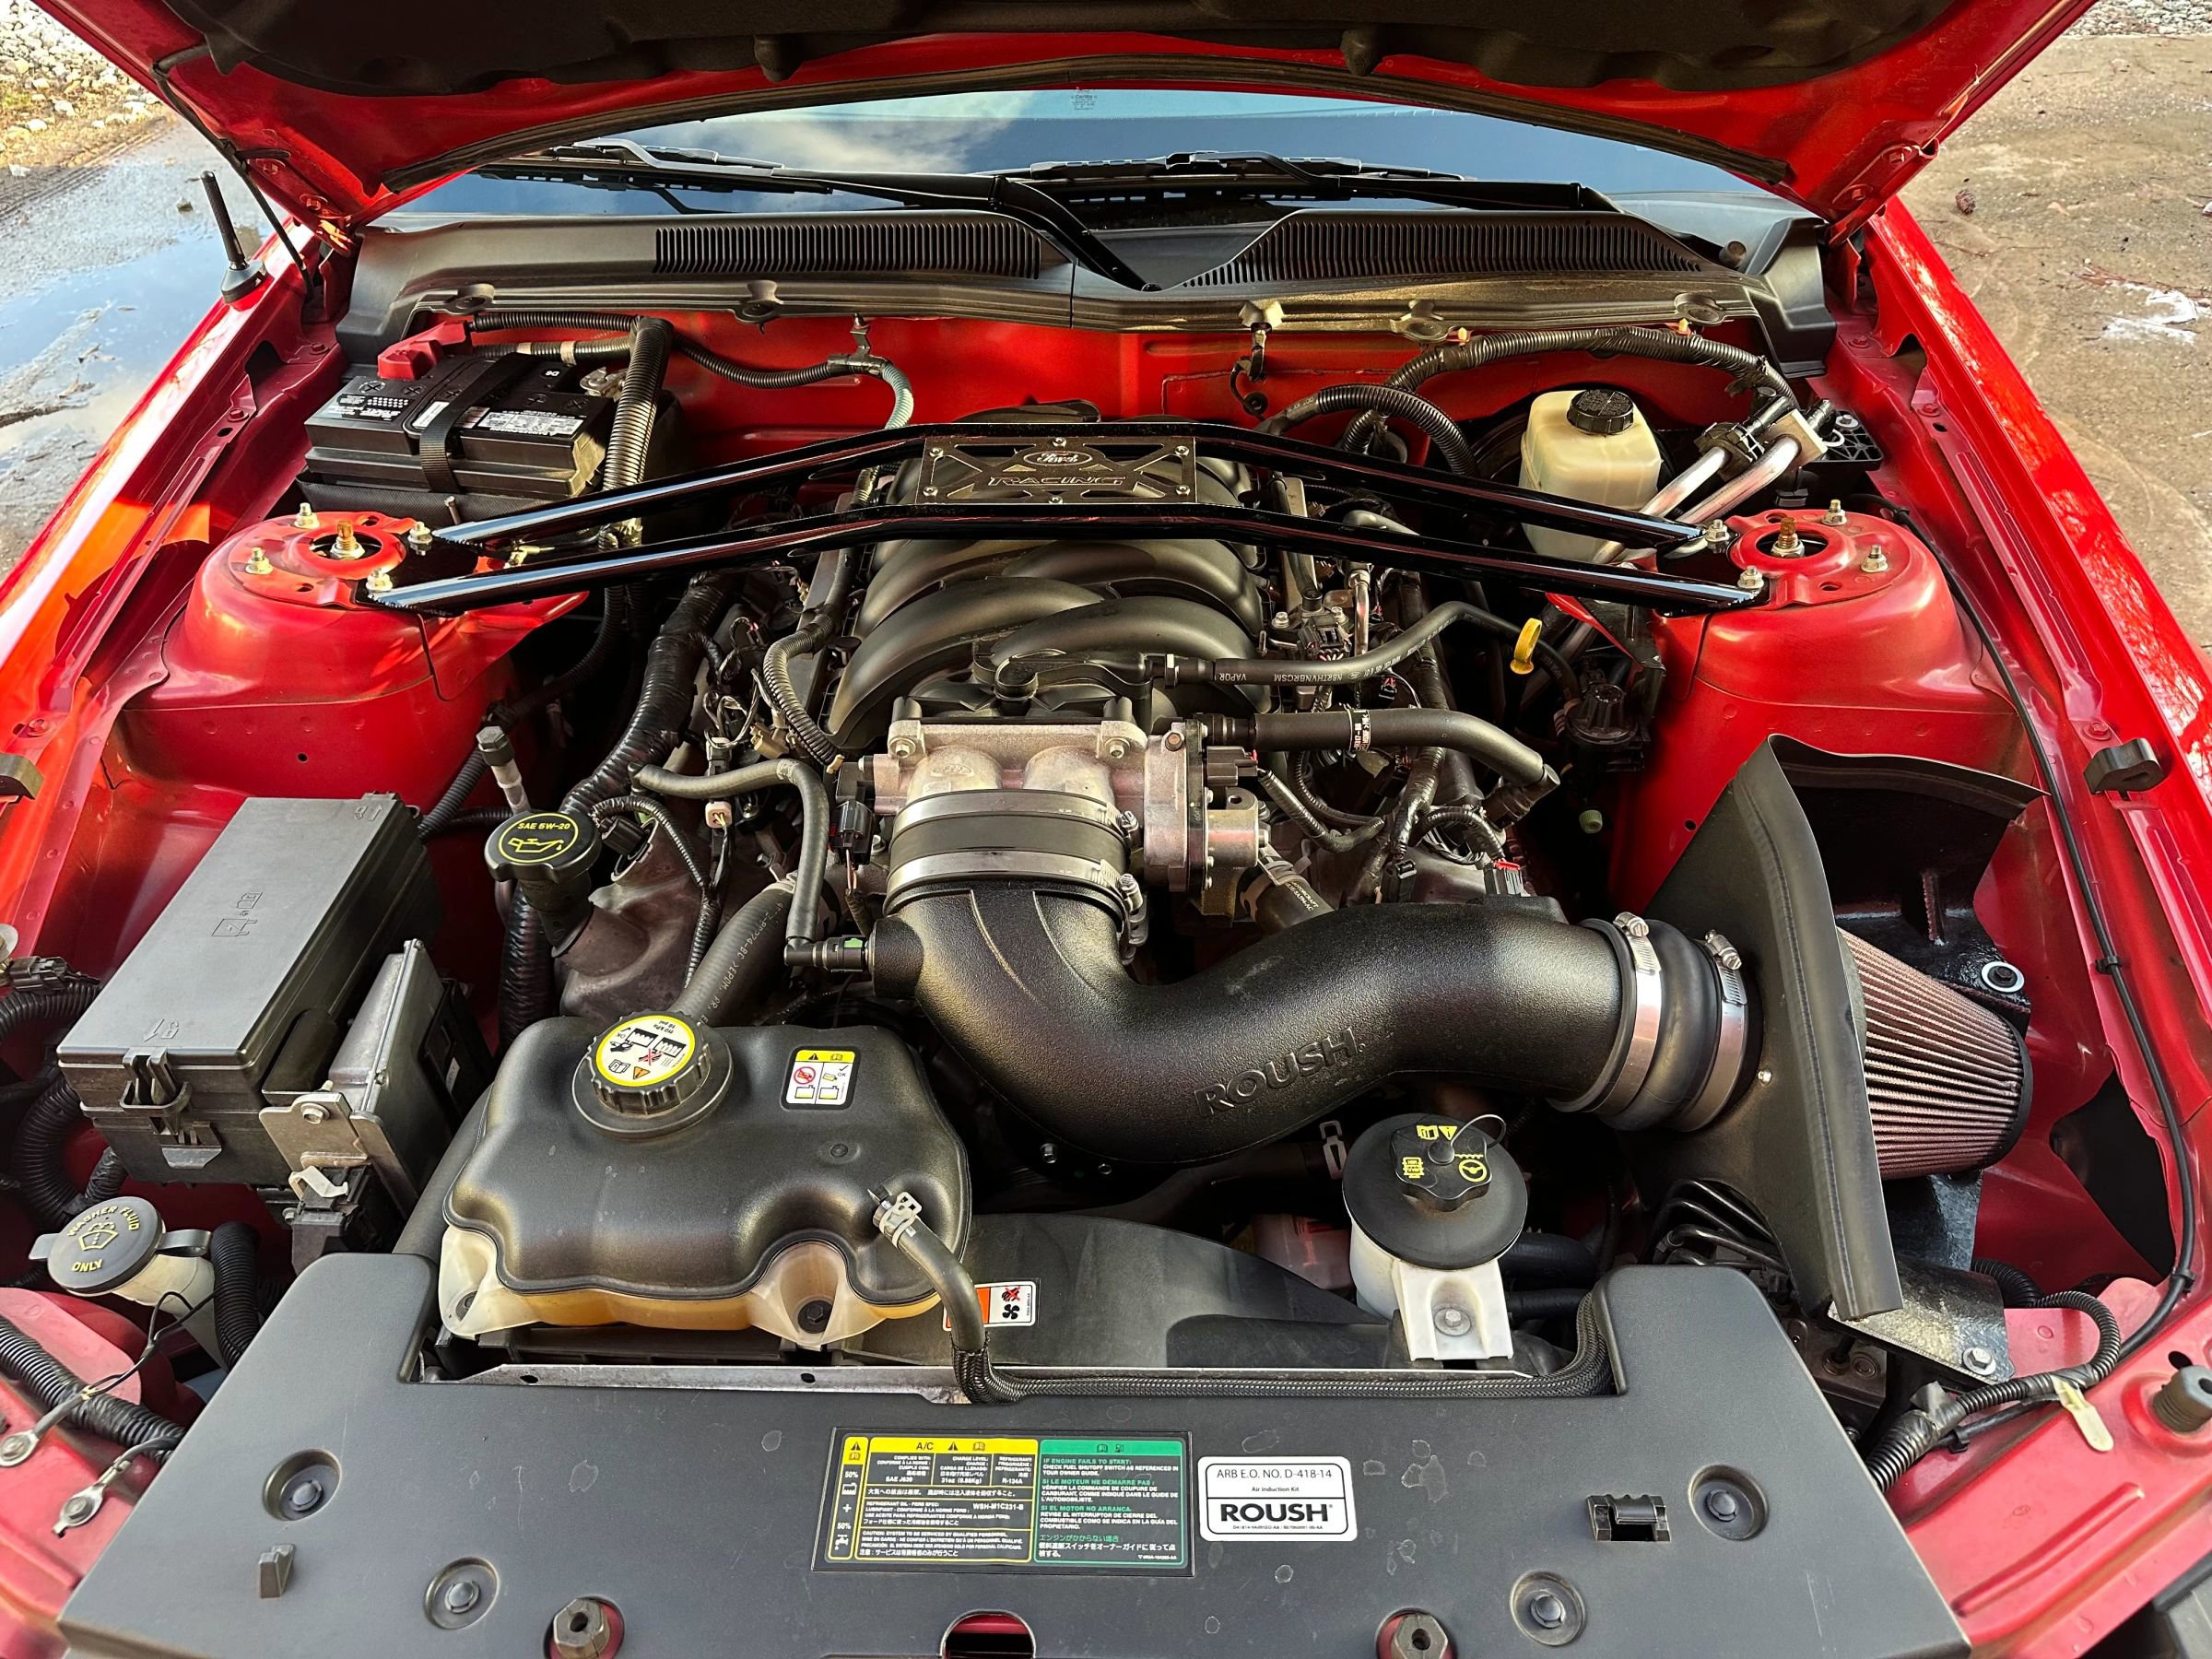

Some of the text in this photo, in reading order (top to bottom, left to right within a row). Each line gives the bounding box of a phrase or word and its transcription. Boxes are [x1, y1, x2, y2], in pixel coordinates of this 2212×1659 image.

[1036, 452, 1078, 463] Ford
[988, 476, 1127, 487] RACING
[1219, 673, 1246, 682] VAPOR
[1194, 1026, 1359, 1115] ROUSH
[67, 1206, 141, 1237] WASHER FLUID
[71, 1259, 103, 1272] ONLY
[916, 1442, 934, 1450] A/C
[1217, 1469, 1332, 1478] ARB E.O. NO. D-418-14
